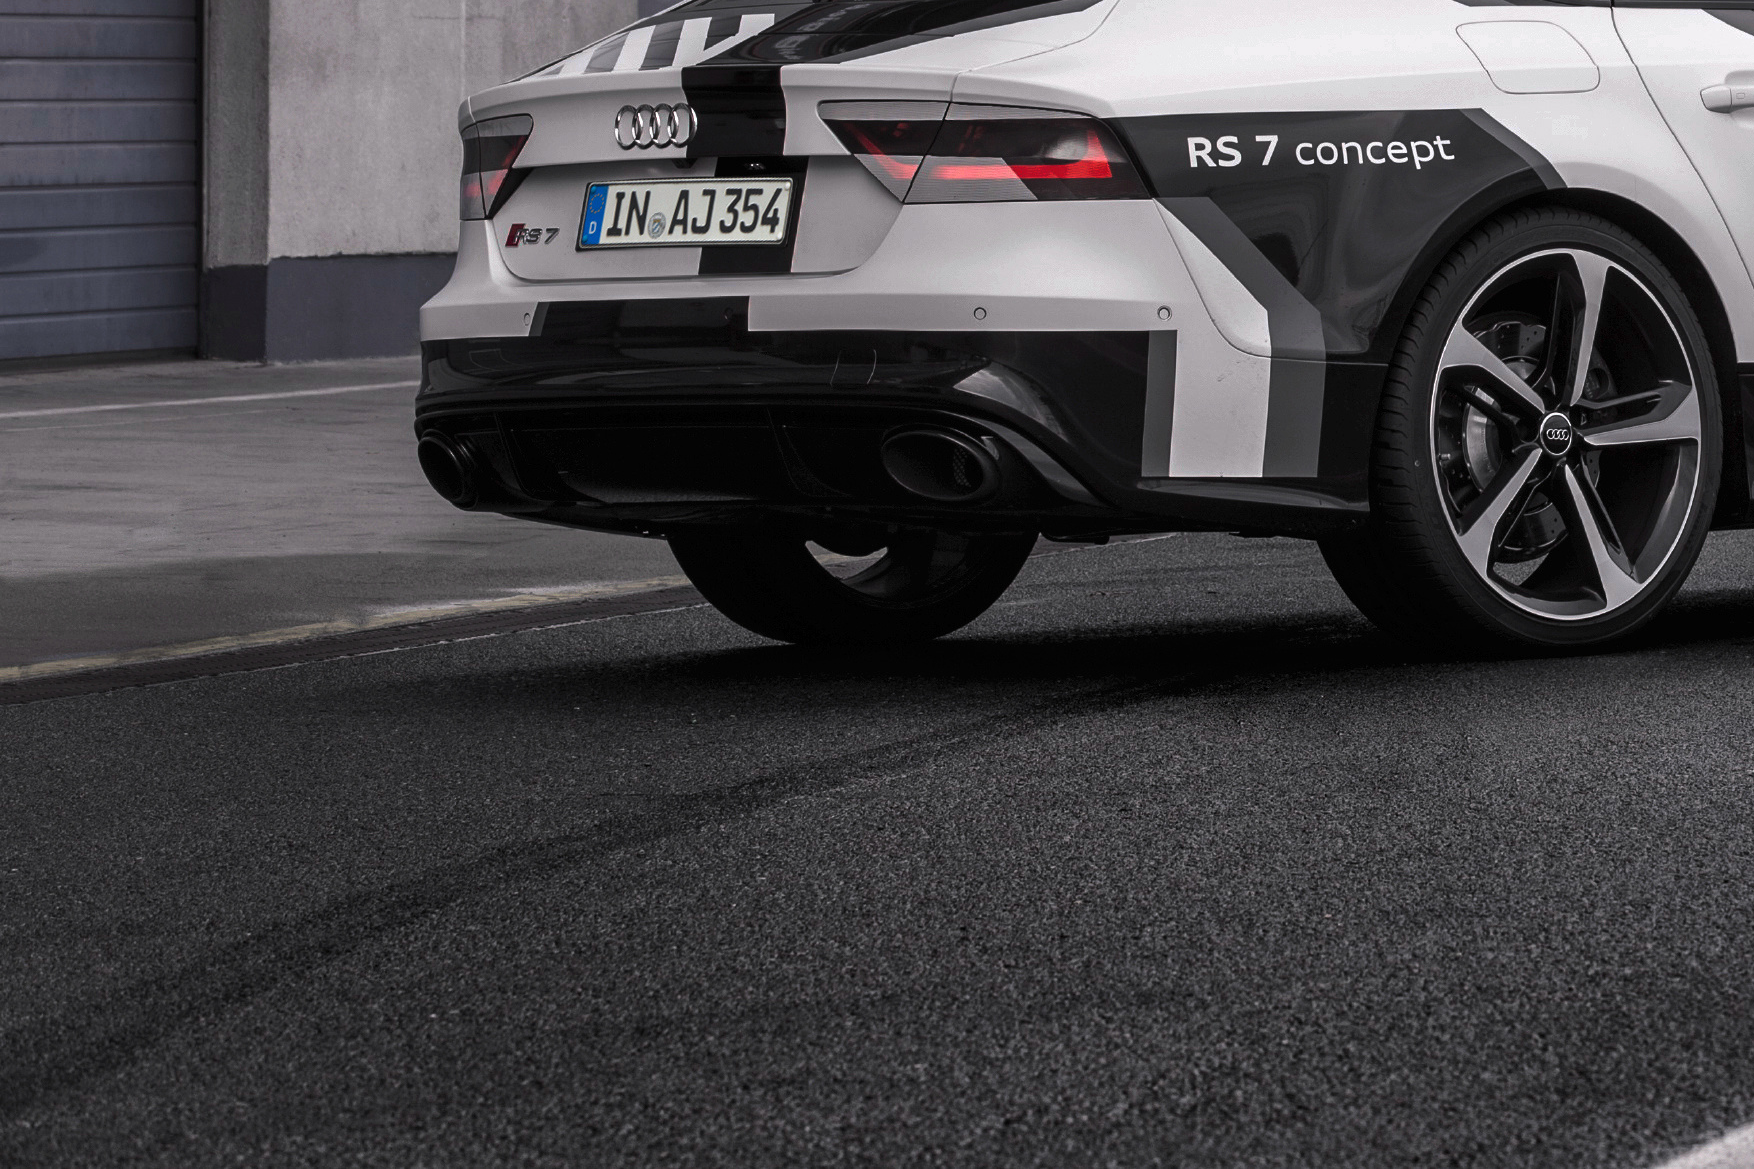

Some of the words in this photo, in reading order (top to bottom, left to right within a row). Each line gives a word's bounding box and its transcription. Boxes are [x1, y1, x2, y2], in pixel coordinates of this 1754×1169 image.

[1187, 135, 1242, 168] RS
[1255, 134, 1279, 166] 7
[1295, 135, 1455, 170] concept
[589, 220, 597, 235] D
[606, 190, 651, 237] IN
